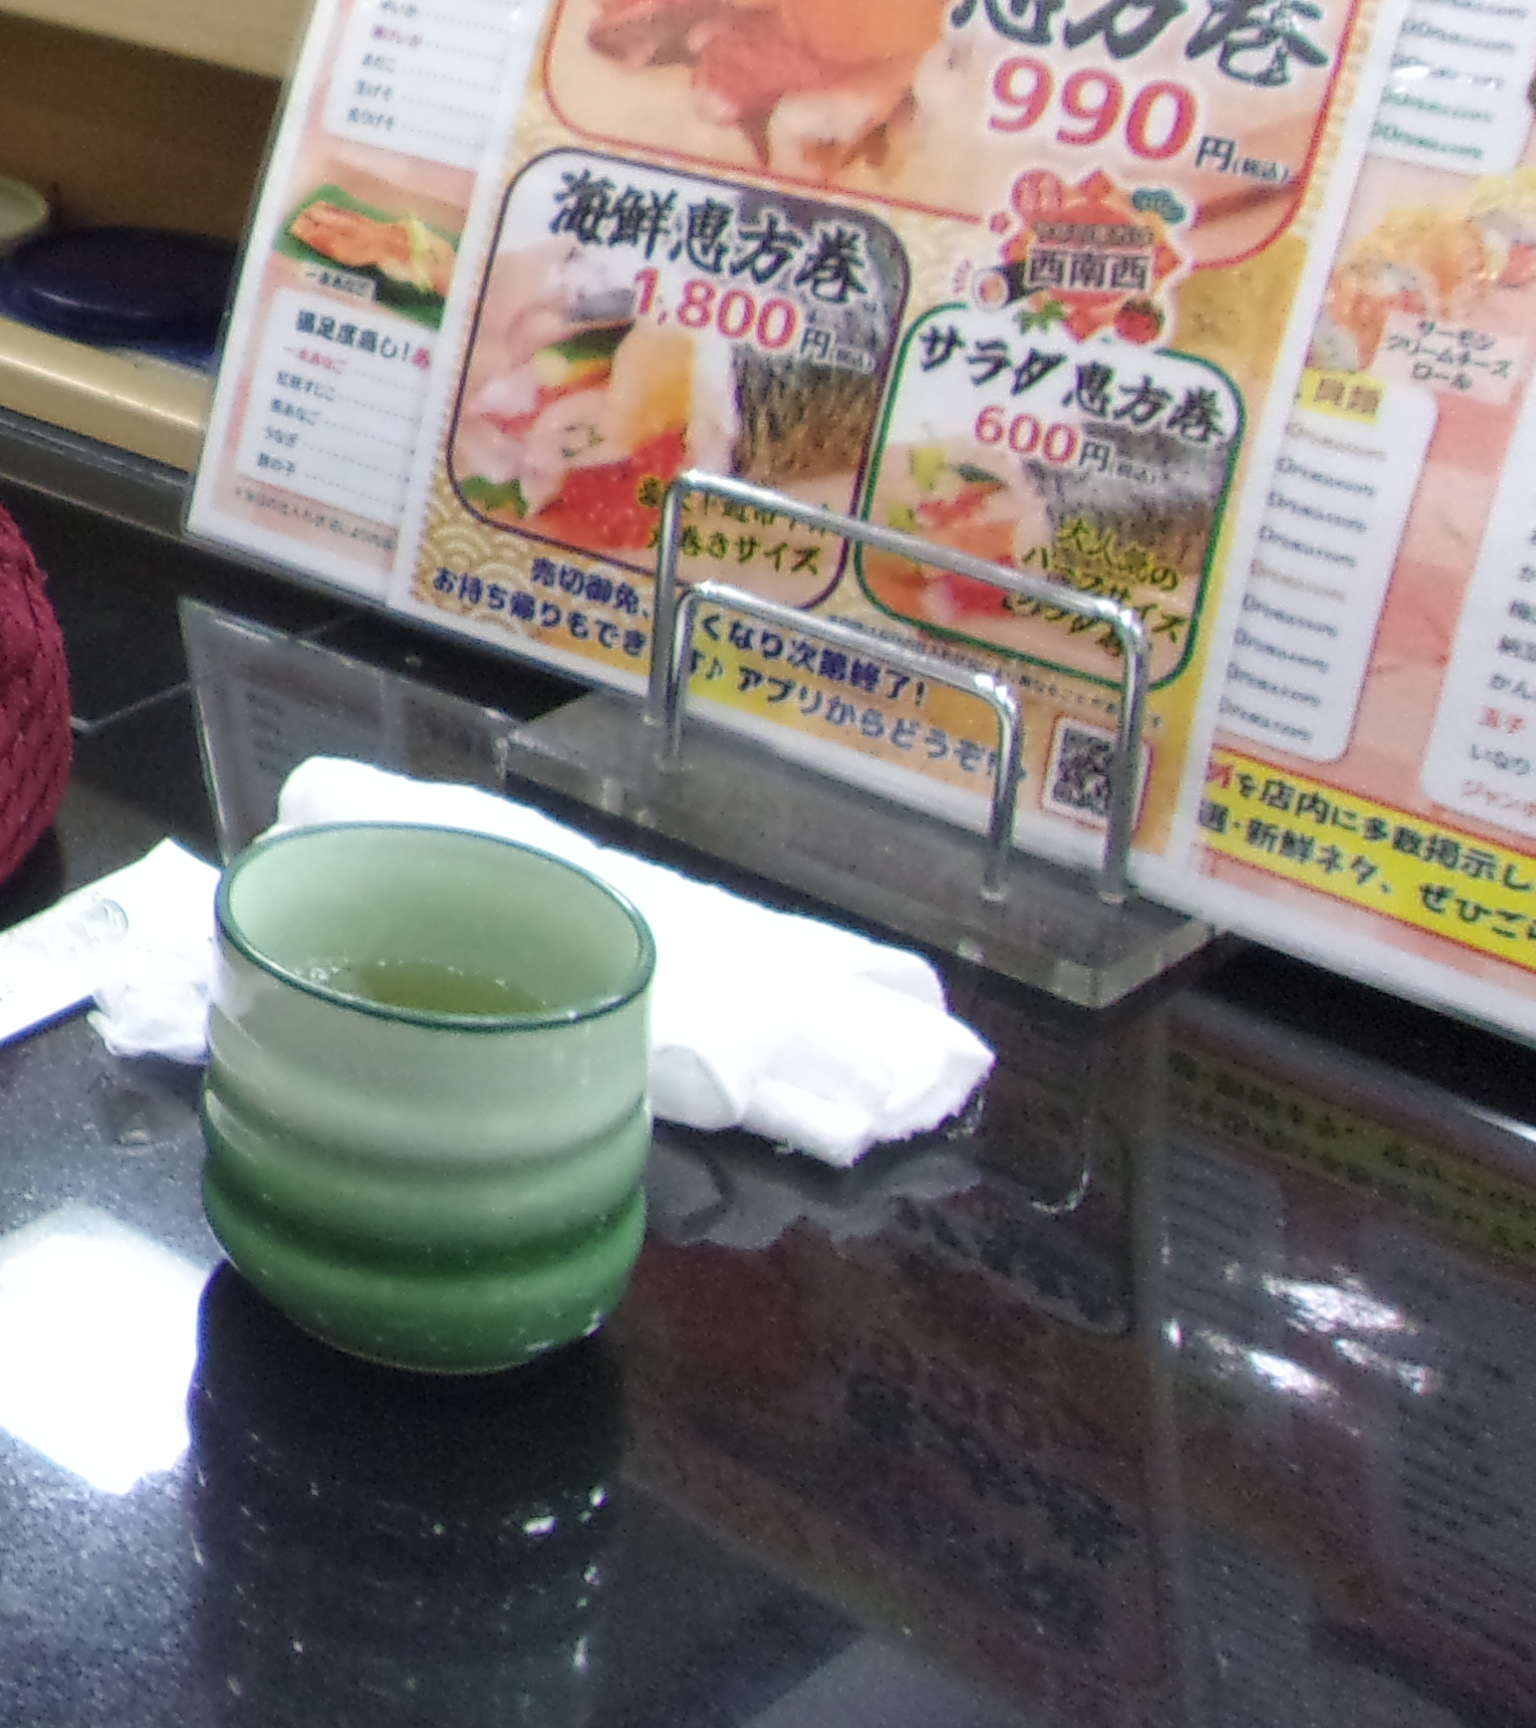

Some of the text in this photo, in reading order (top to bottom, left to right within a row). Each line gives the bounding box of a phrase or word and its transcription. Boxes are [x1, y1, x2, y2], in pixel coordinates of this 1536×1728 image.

[549, 168, 868, 304] 海鮮恵方巻
[1029, 249, 1149, 290] 西南西
[919, 325, 1225, 443] サラダ恵方巻
[646, 525, 821, 576] 巻きサイズ
